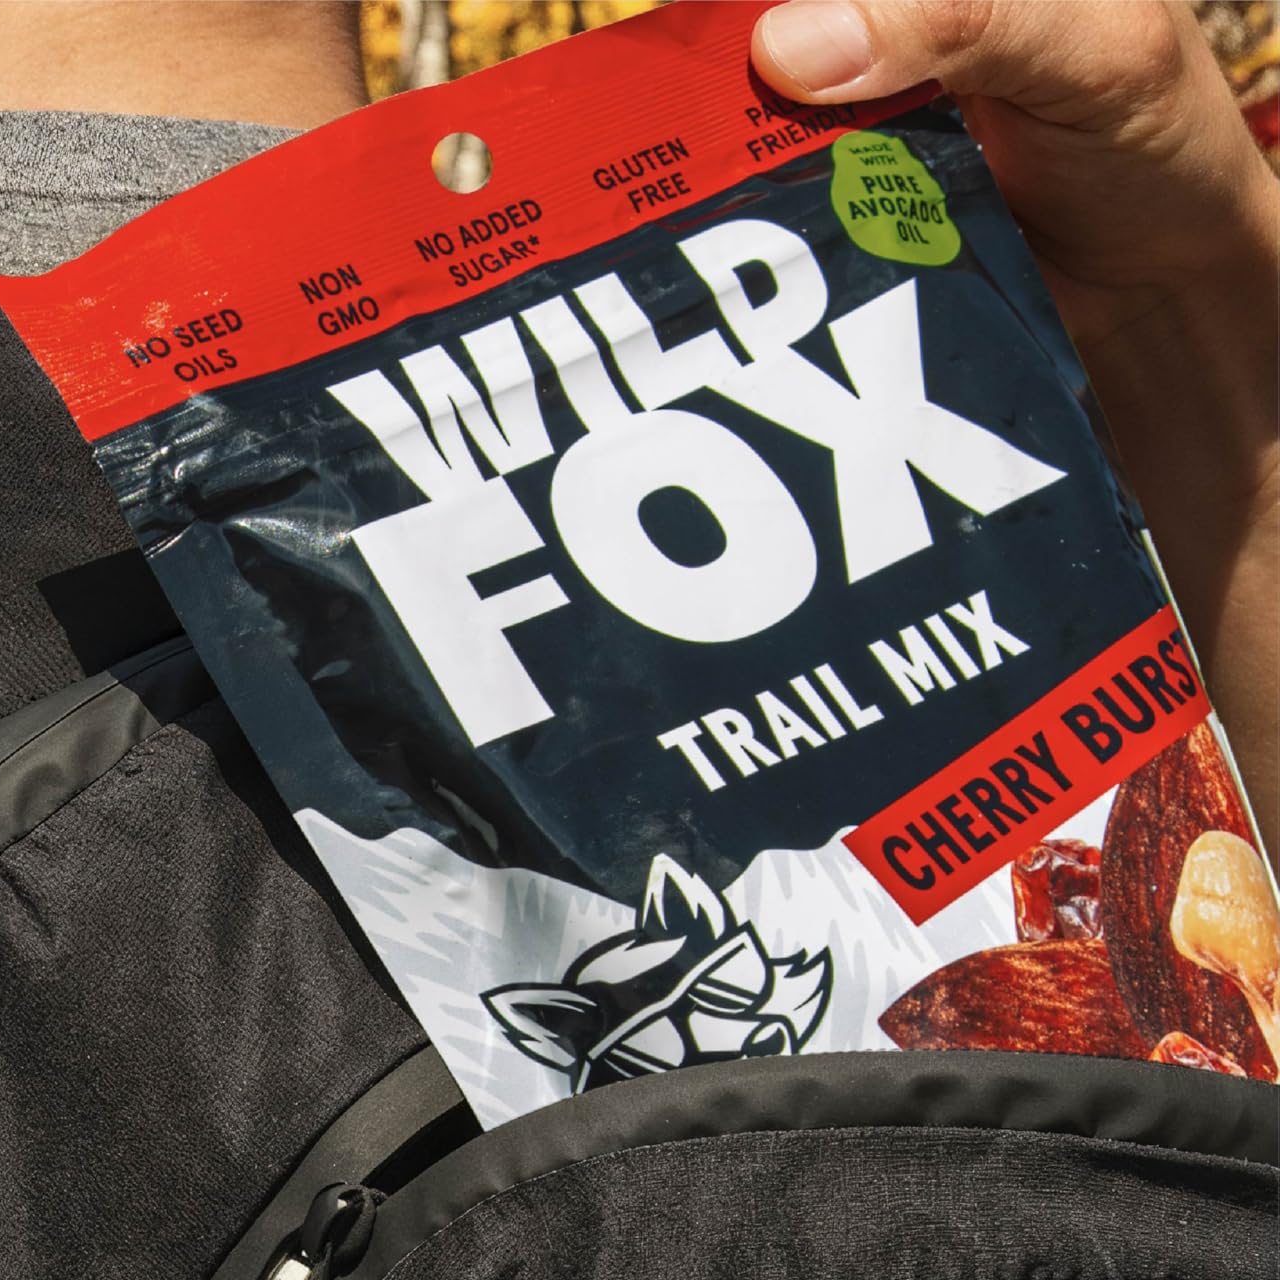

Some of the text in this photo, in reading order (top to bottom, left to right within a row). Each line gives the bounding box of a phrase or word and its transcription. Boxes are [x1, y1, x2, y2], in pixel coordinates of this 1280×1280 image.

[744, 98, 803, 128] PAL
[746, 104, 857, 162] FRIENDLY
[593, 138, 690, 191] GLUTEN
[861, 156, 898, 166] WITH
[627, 172, 691, 214] FREE
[861, 176, 923, 195] PURE
[414, 199, 543, 263] NO ADDED
[848, 198, 944, 225] AVOCADO
[897, 221, 930, 244] OIL
[299, 264, 362, 304] NON
[317, 297, 380, 337] GMO
[124, 308, 244, 369] NO SEED
[173, 348, 238, 384] OILS
[326, 218, 828, 502] WILD
[351, 277, 1069, 748] FOX
[657, 590, 1032, 792] TRAIL MIX
[880, 732, 1074, 892] CHERRY
